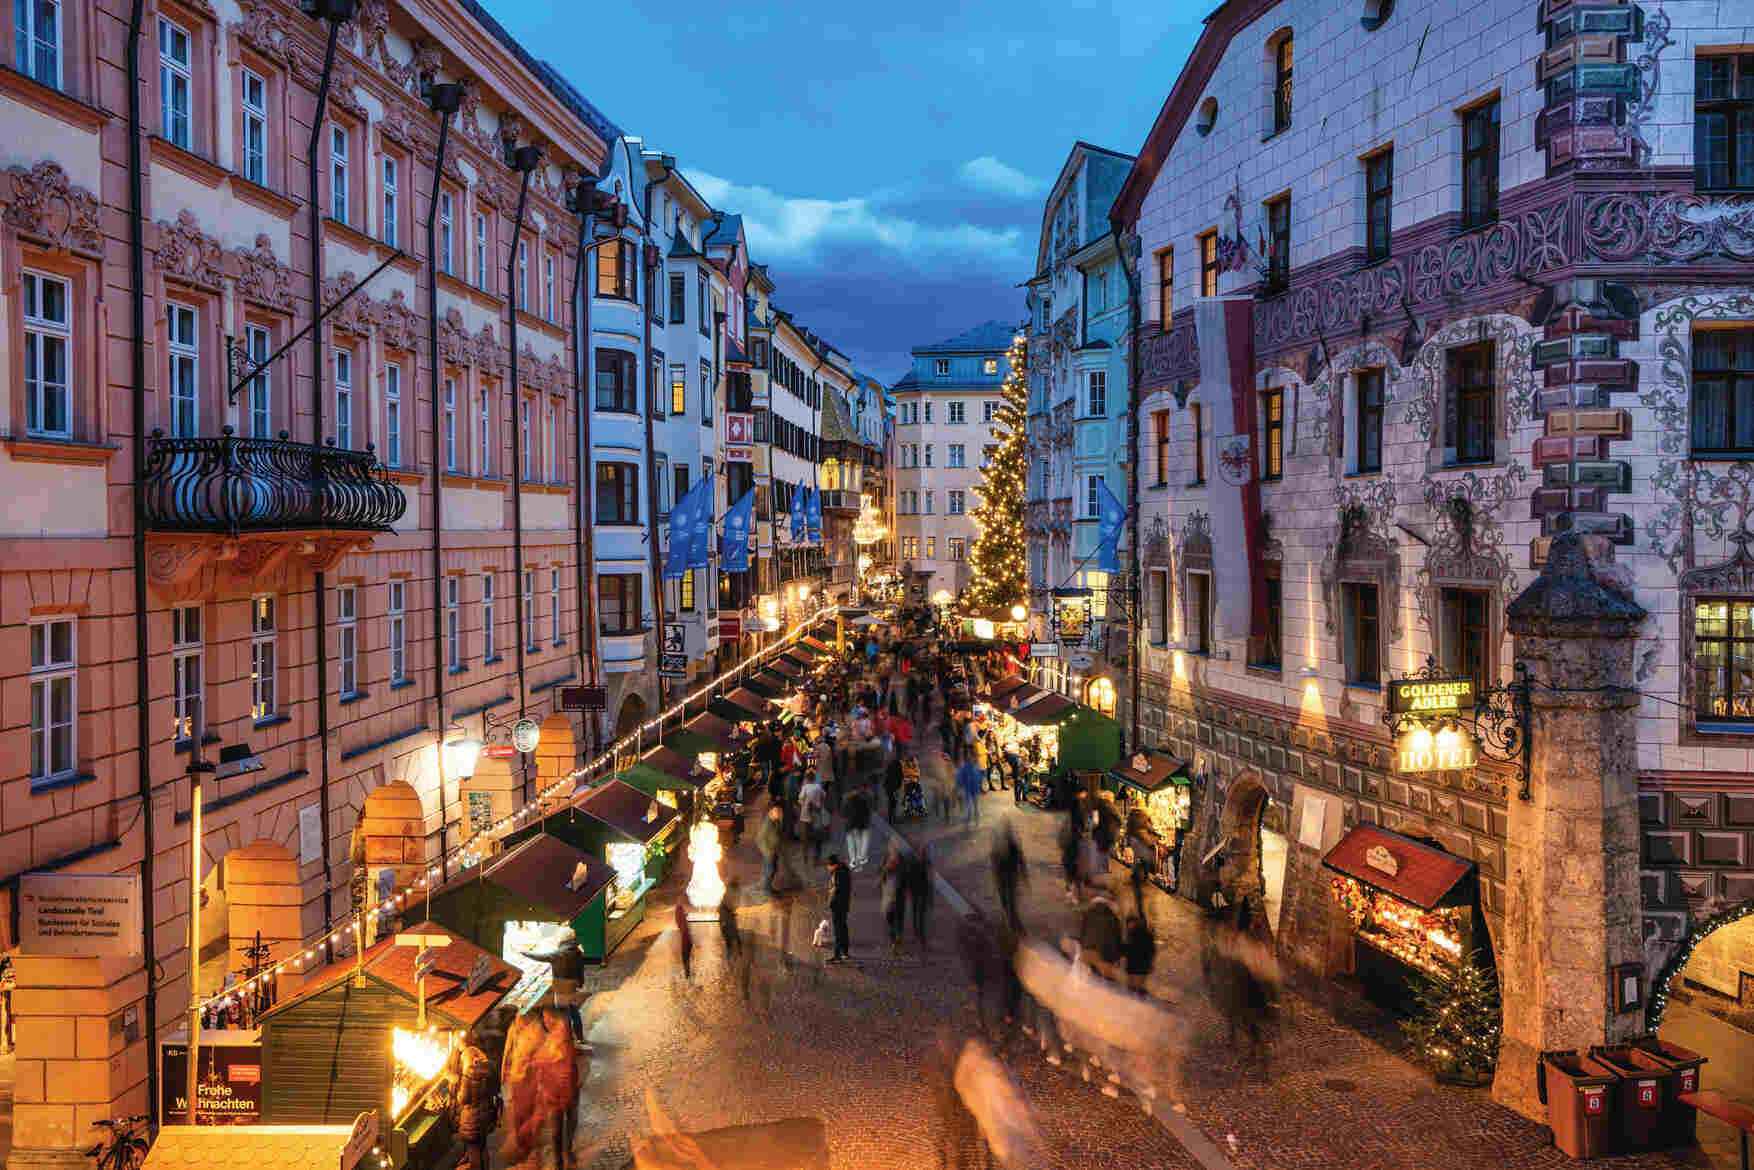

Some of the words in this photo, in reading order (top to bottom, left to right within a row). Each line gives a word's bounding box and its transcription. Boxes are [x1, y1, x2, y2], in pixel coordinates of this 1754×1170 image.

[1400, 682, 1471, 698] GOLDENER
[1411, 695, 1457, 710] ADLER
[1400, 749, 1478, 769] HOTEL
[198, 1085, 233, 1096] Frohe
[175, 1097, 255, 1110] Whnachten
